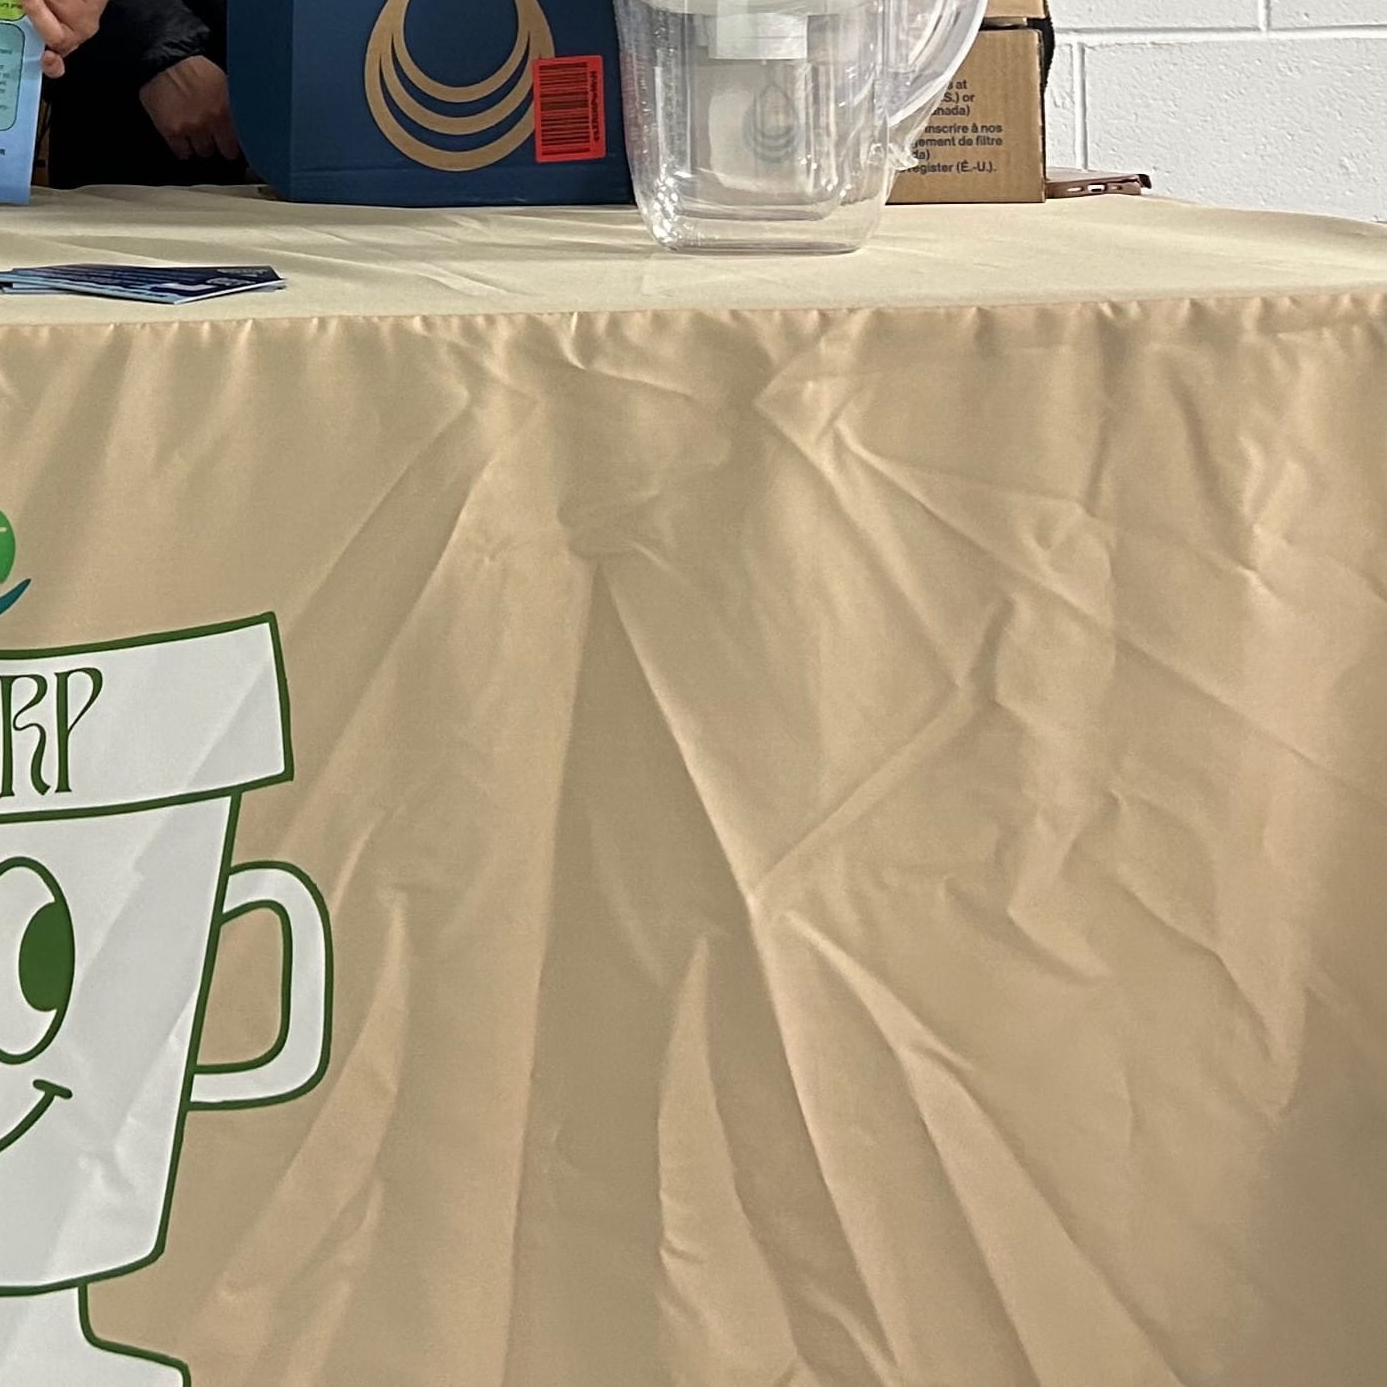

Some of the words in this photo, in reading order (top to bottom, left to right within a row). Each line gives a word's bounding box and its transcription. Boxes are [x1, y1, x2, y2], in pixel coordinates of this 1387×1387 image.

[956, 80, 967, 90] at
[971, 122, 978, 134] à
[980, 125, 1003, 134] nos
[958, 136, 974, 146] de
[975, 136, 1003, 146] filtre
